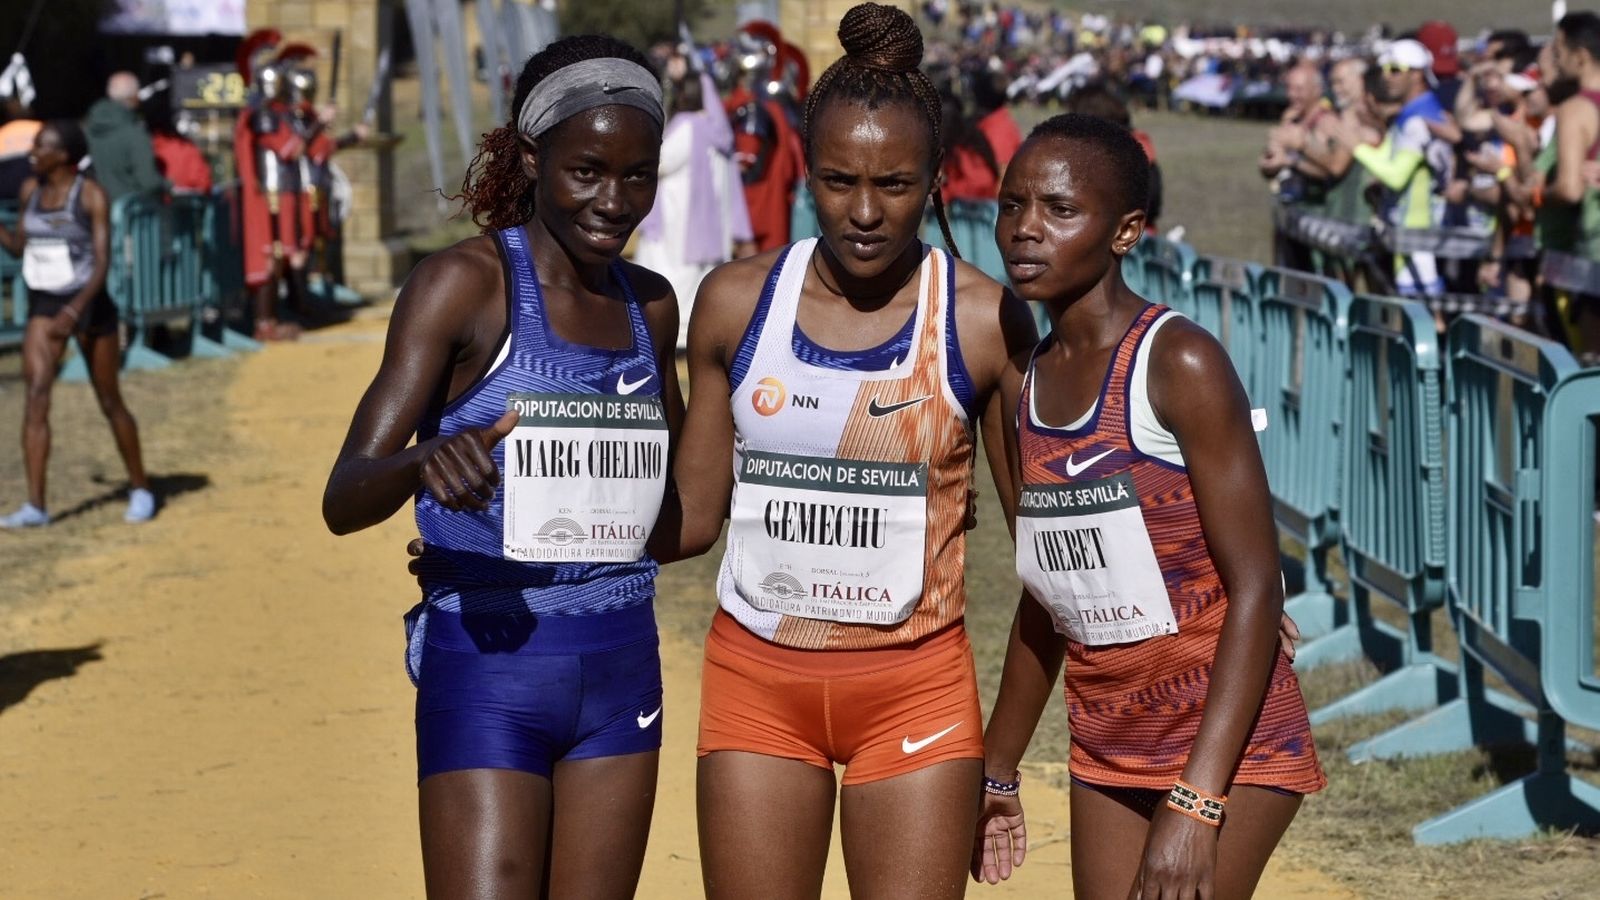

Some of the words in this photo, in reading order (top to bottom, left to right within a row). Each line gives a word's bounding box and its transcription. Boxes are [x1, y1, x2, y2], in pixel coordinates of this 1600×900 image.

[514, 400, 603, 418] DIPUTACION
[606, 402, 621, 419] DE
[624, 403, 663, 421] SEVILLA
[792, 394, 819, 409] NN
[513, 439, 581, 479] MARG
[587, 439, 662, 480] CHELIMO
[746, 458, 832, 483] DIPUTACION
[836, 467, 856, 484] DE
[860, 469, 919, 487] SEVILLA
[1059, 490, 1075, 508] DE
[1075, 481, 1130, 507] SEVILLA
[591, 520, 647, 540] ITÁLICA
[764, 498, 889, 549] GEMECHU
[1034, 527, 1108, 573] CHEBET
[811, 580, 892, 603] ITÁLICA
[805, 604, 862, 619] PATRIMONIO
[1078, 604, 1146, 624] ITÁLICA
